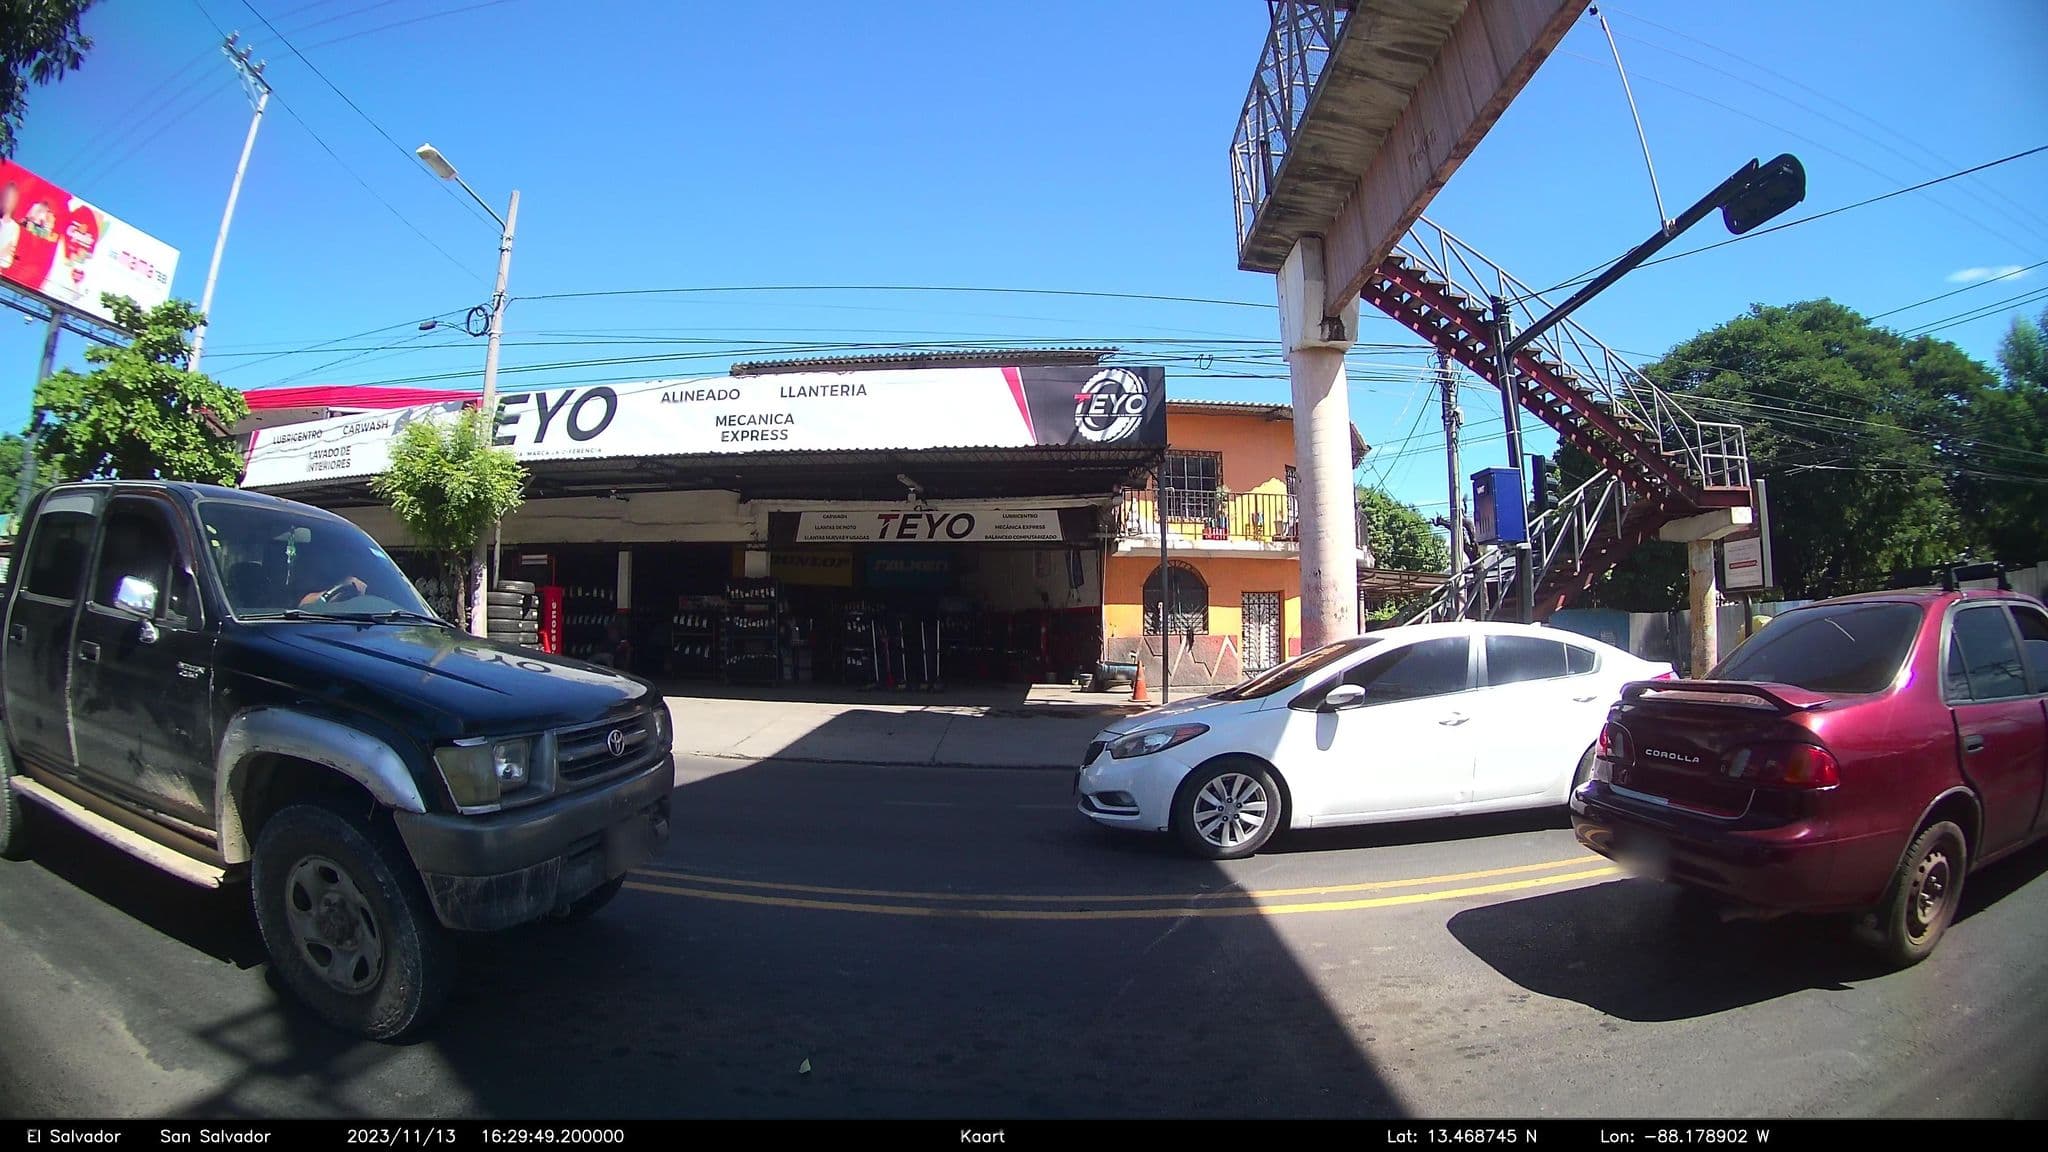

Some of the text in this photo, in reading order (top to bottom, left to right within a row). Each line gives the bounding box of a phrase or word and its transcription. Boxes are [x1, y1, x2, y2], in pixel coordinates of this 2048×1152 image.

[661, 388, 741, 403] ALINEADO
[780, 383, 868, 398] LLANTERIA
[1074, 393, 1148, 414] TEYO
[462, 386, 618, 446] EYO
[715, 413, 795, 427] MECANICA
[343, 419, 389, 435] CARWASH
[273, 429, 323, 444] LUBRICENTRO
[721, 429, 789, 442] EXPRESS
[309, 446, 351, 459] LAVADO DE
[307, 459, 351, 472] INTERIORES
[877, 512, 976, 540] TEYO
[1645, 749, 1700, 763] COROLLA
